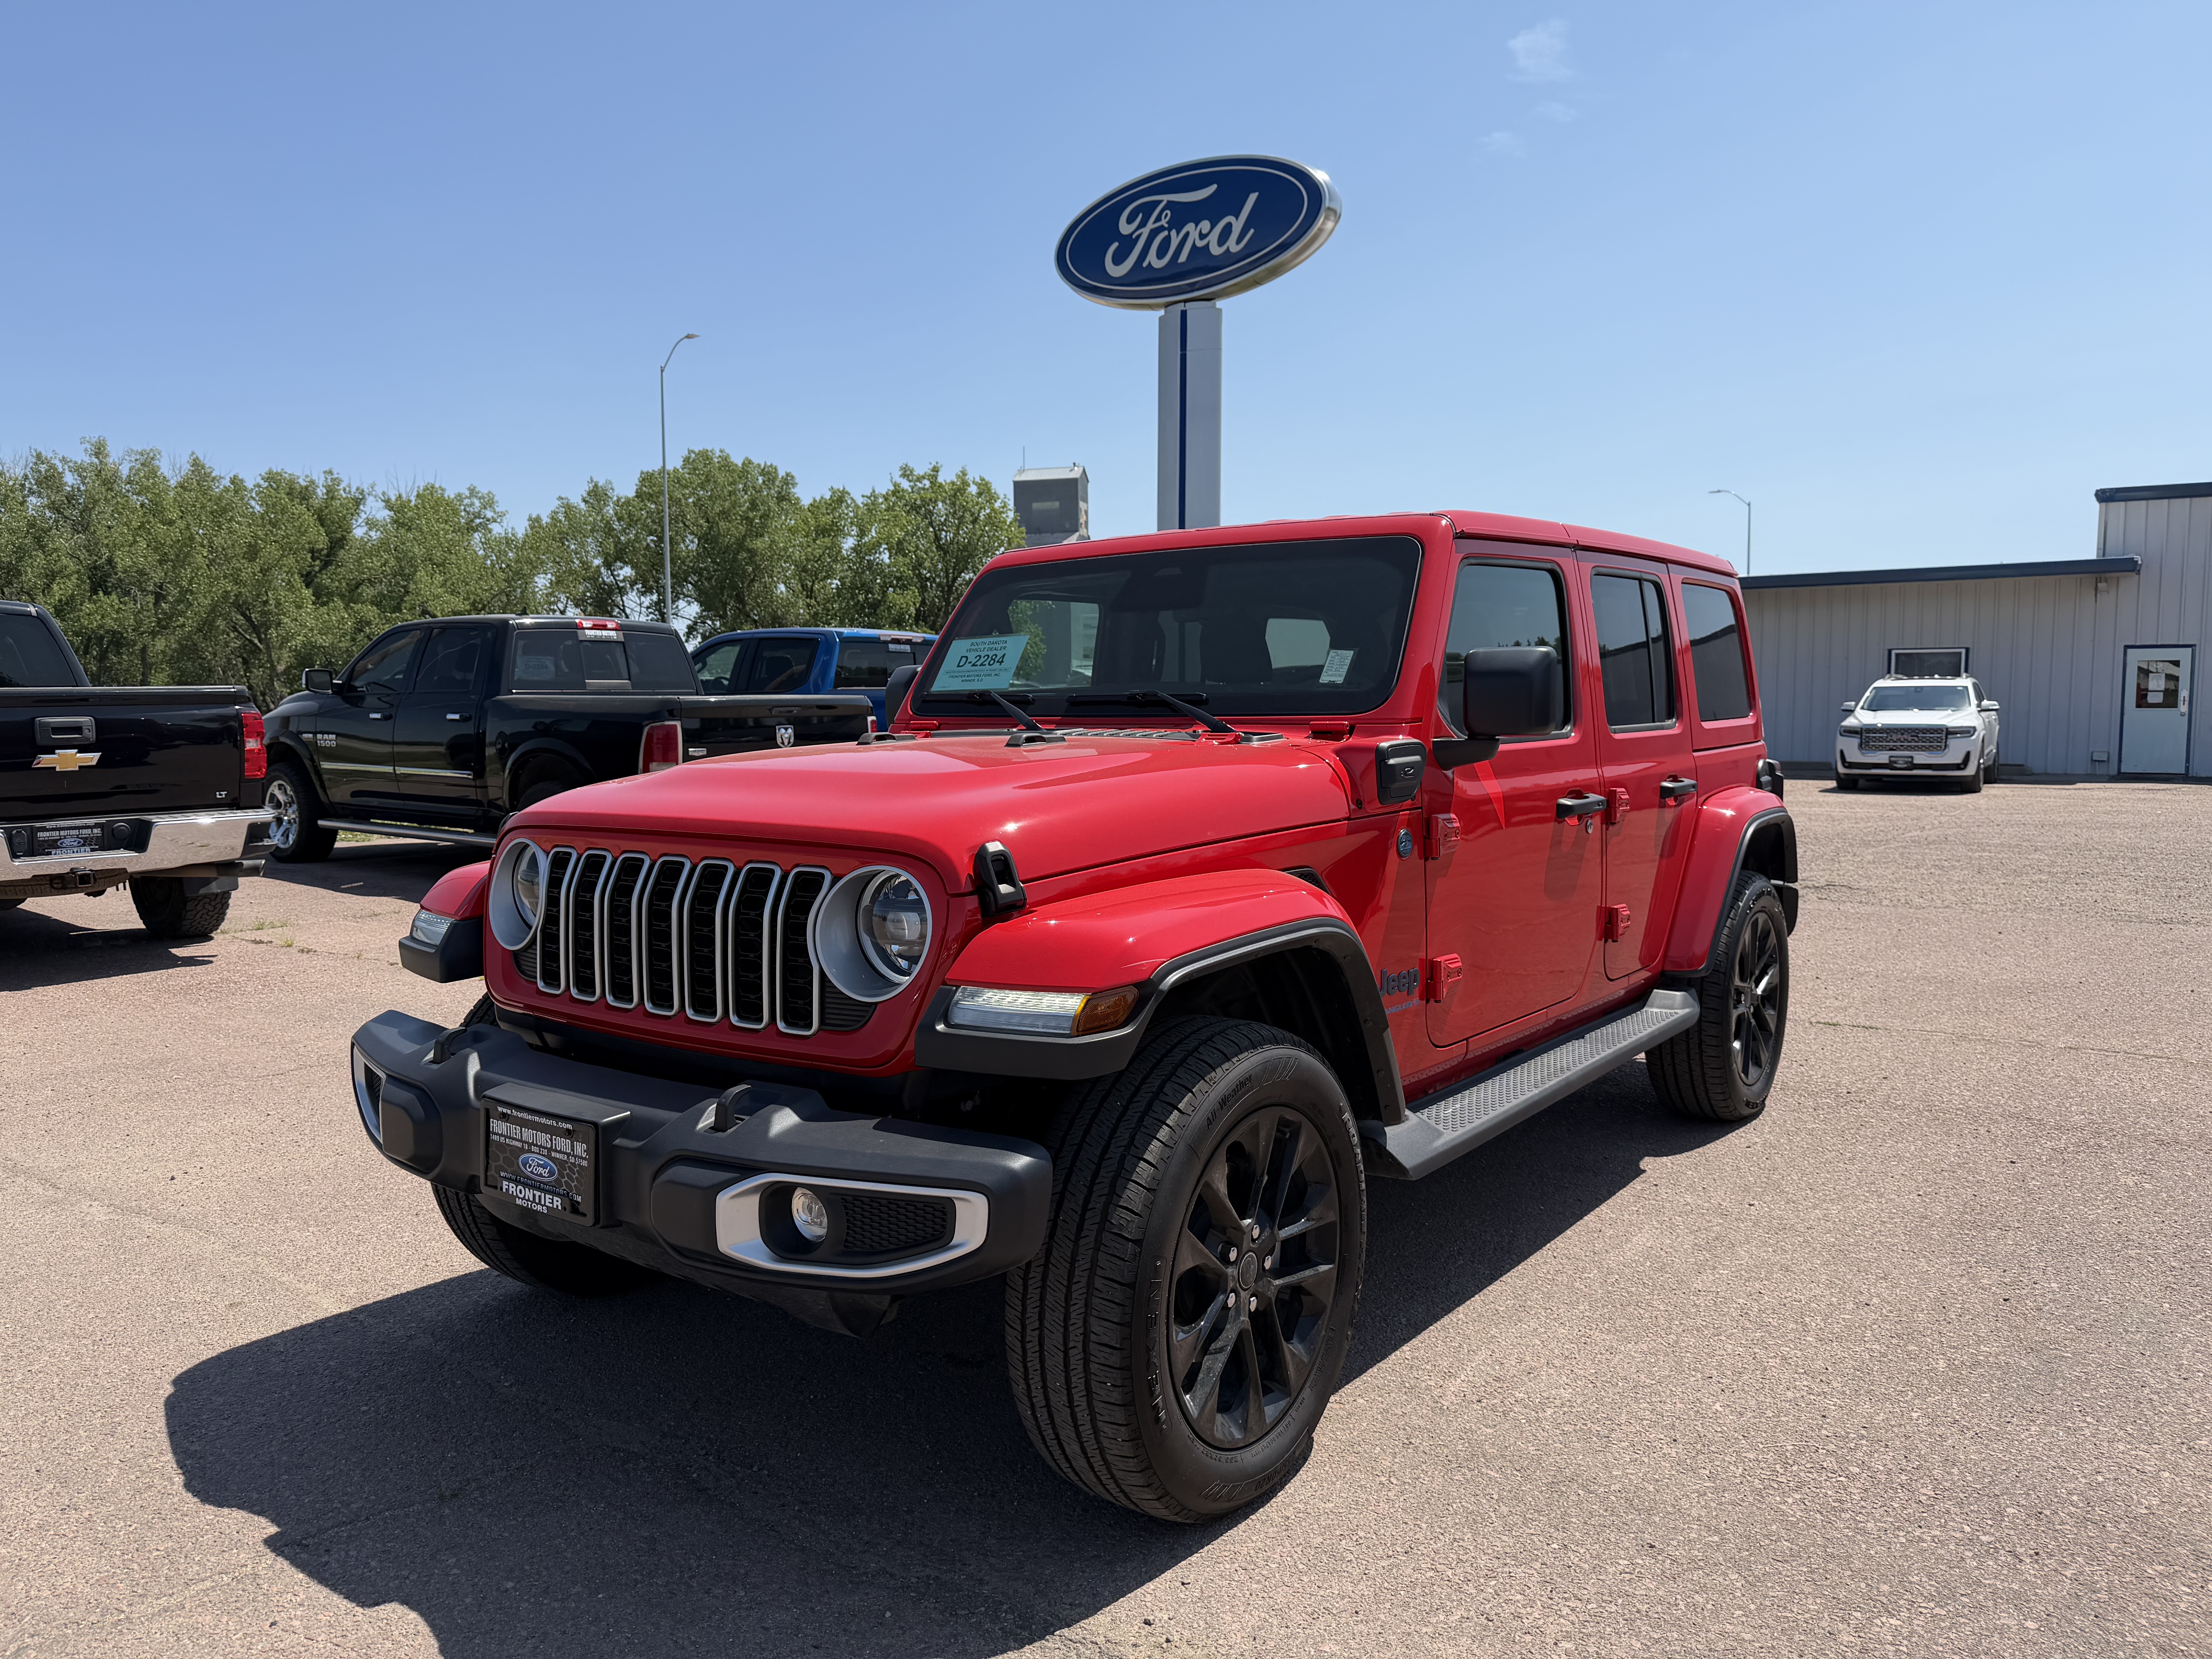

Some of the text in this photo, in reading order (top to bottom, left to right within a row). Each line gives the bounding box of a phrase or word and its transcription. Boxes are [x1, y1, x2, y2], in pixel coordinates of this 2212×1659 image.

[1104, 184, 1259, 277] Ford
[957, 653, 1006, 668] D-2284
[1379, 968, 1420, 998] Jeep
[1206, 1073, 1252, 1130] All-Weather
[497, 1106, 573, 1130] www.frontiermotors.com
[490, 1118, 588, 1158] FRONTIER MOTORS FORD, INC.
[506, 1138, 522, 1148] HIGHWAY
[576, 1158, 587, 1167] 57580
[527, 1157, 550, 1177] Ford
[503, 1180, 562, 1210] FRONTIER
[516, 1198, 548, 1213] MOTORS
[1146, 1279, 1167, 1425] NEXEN
